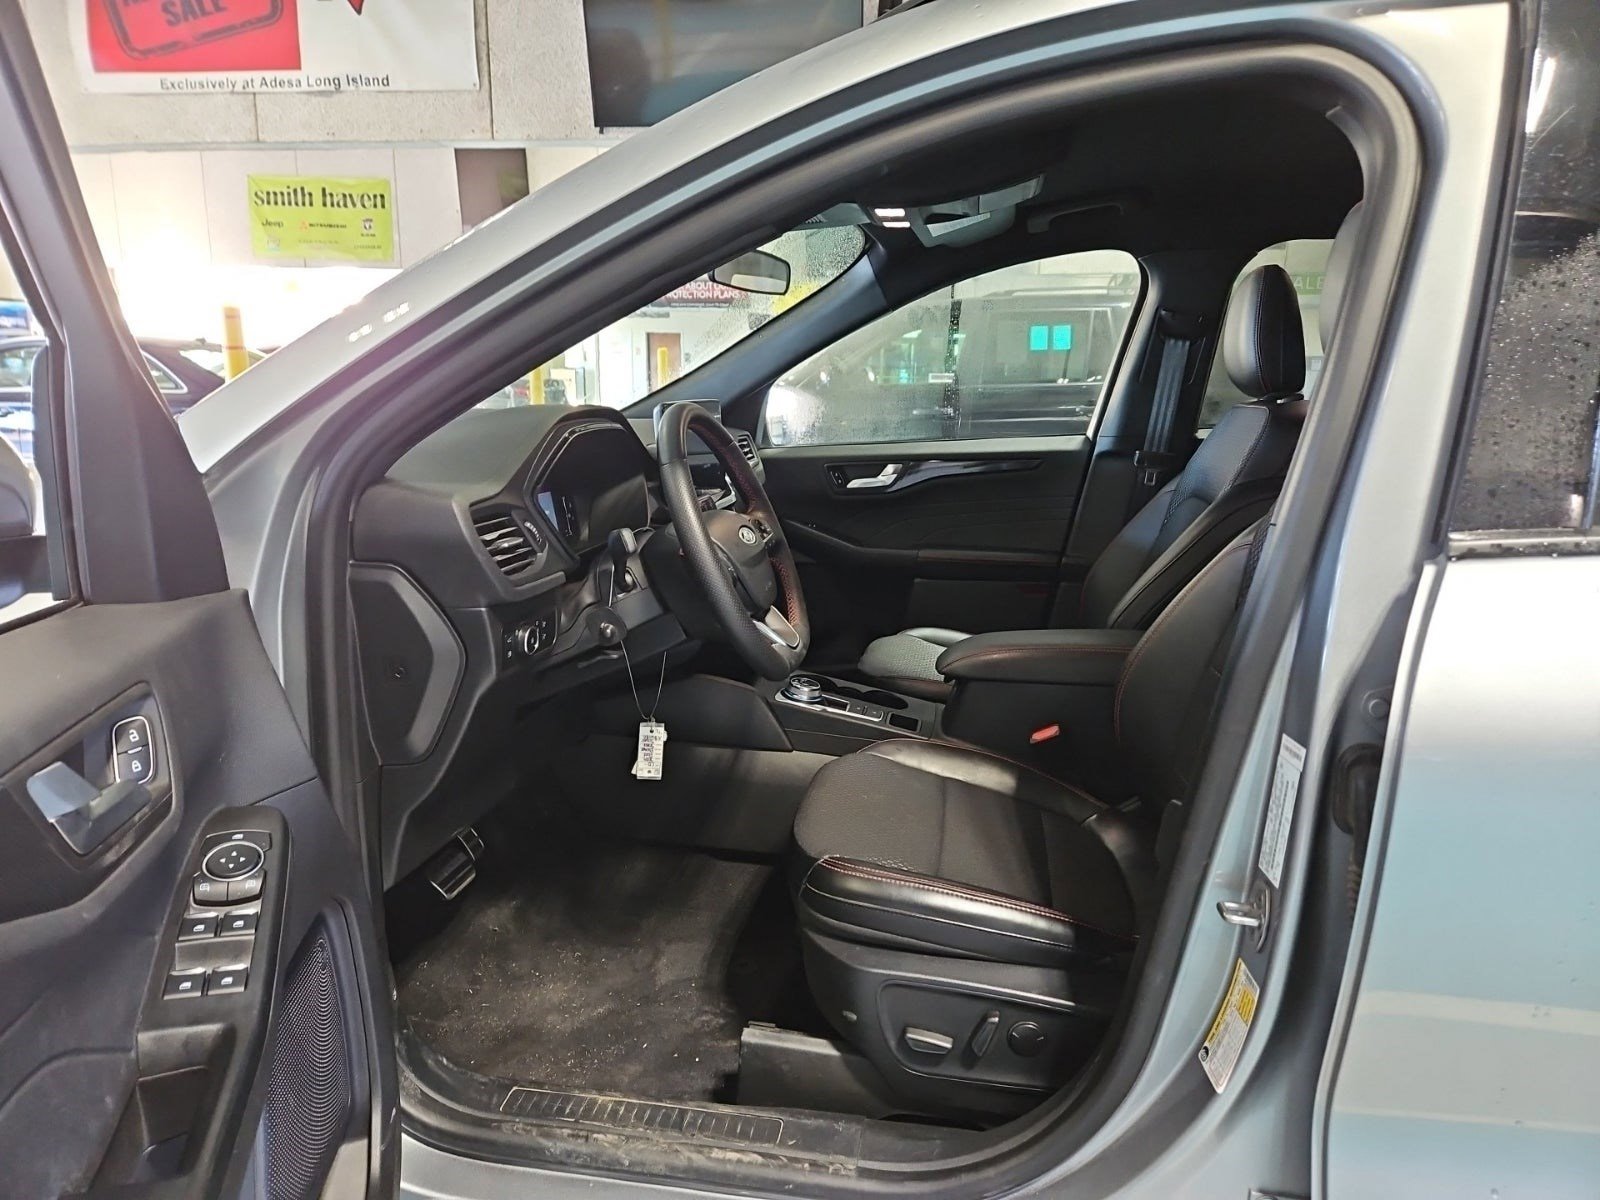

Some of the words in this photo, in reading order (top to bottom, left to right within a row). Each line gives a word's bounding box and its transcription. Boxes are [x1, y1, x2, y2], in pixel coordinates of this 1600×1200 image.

[159, 77, 237, 93] Exclusively
[242, 77, 255, 90] at
[259, 76, 302, 89] Adesa
[307, 74, 341, 91] Long
[346, 74, 390, 88] Island
[254, 185, 314, 207] smith
[321, 186, 386, 209] haven
[686, 281, 713, 290] ABOUT
